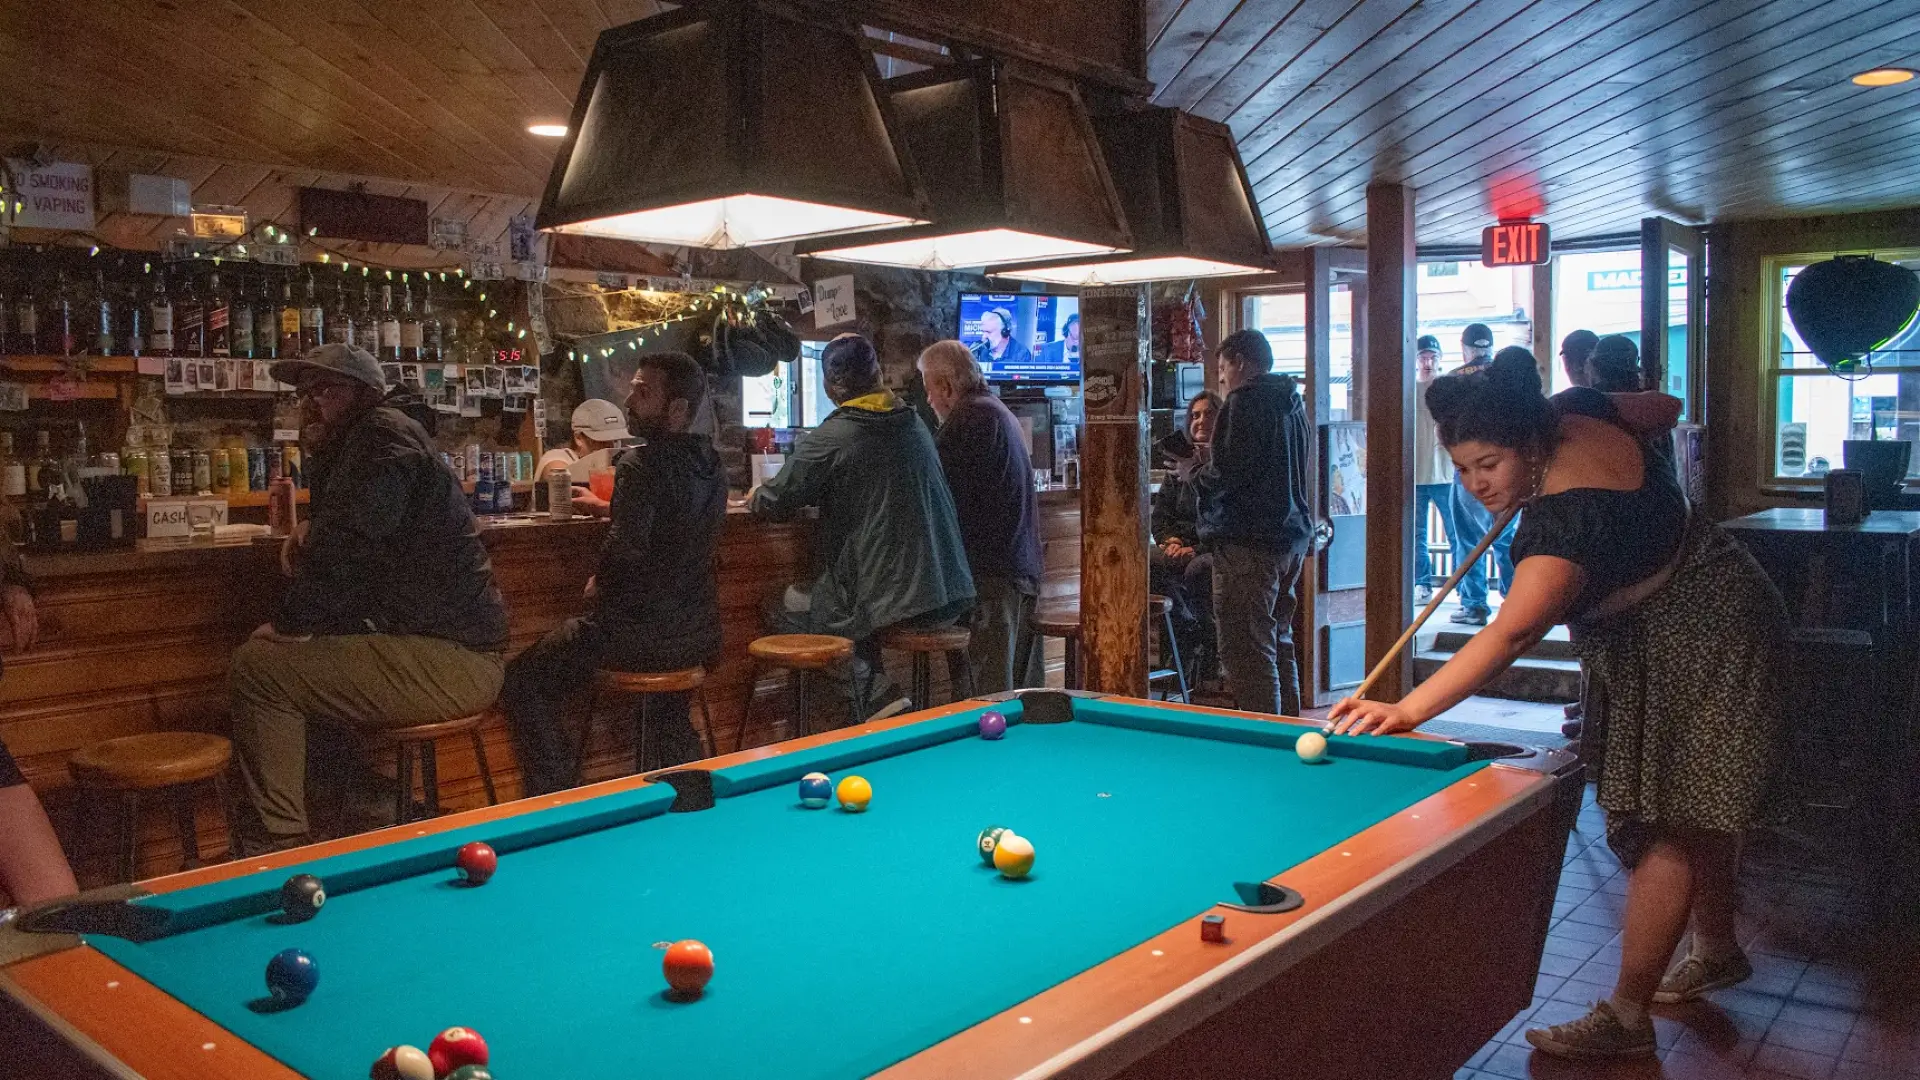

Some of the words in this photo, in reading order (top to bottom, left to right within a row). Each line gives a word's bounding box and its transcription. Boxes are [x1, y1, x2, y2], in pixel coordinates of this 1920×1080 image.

[30, 173, 88, 192] SMOKING
[34, 196, 86, 214] VAPING
[1493, 224, 1541, 264] EXIT
[153, 511, 186, 525] CASH
